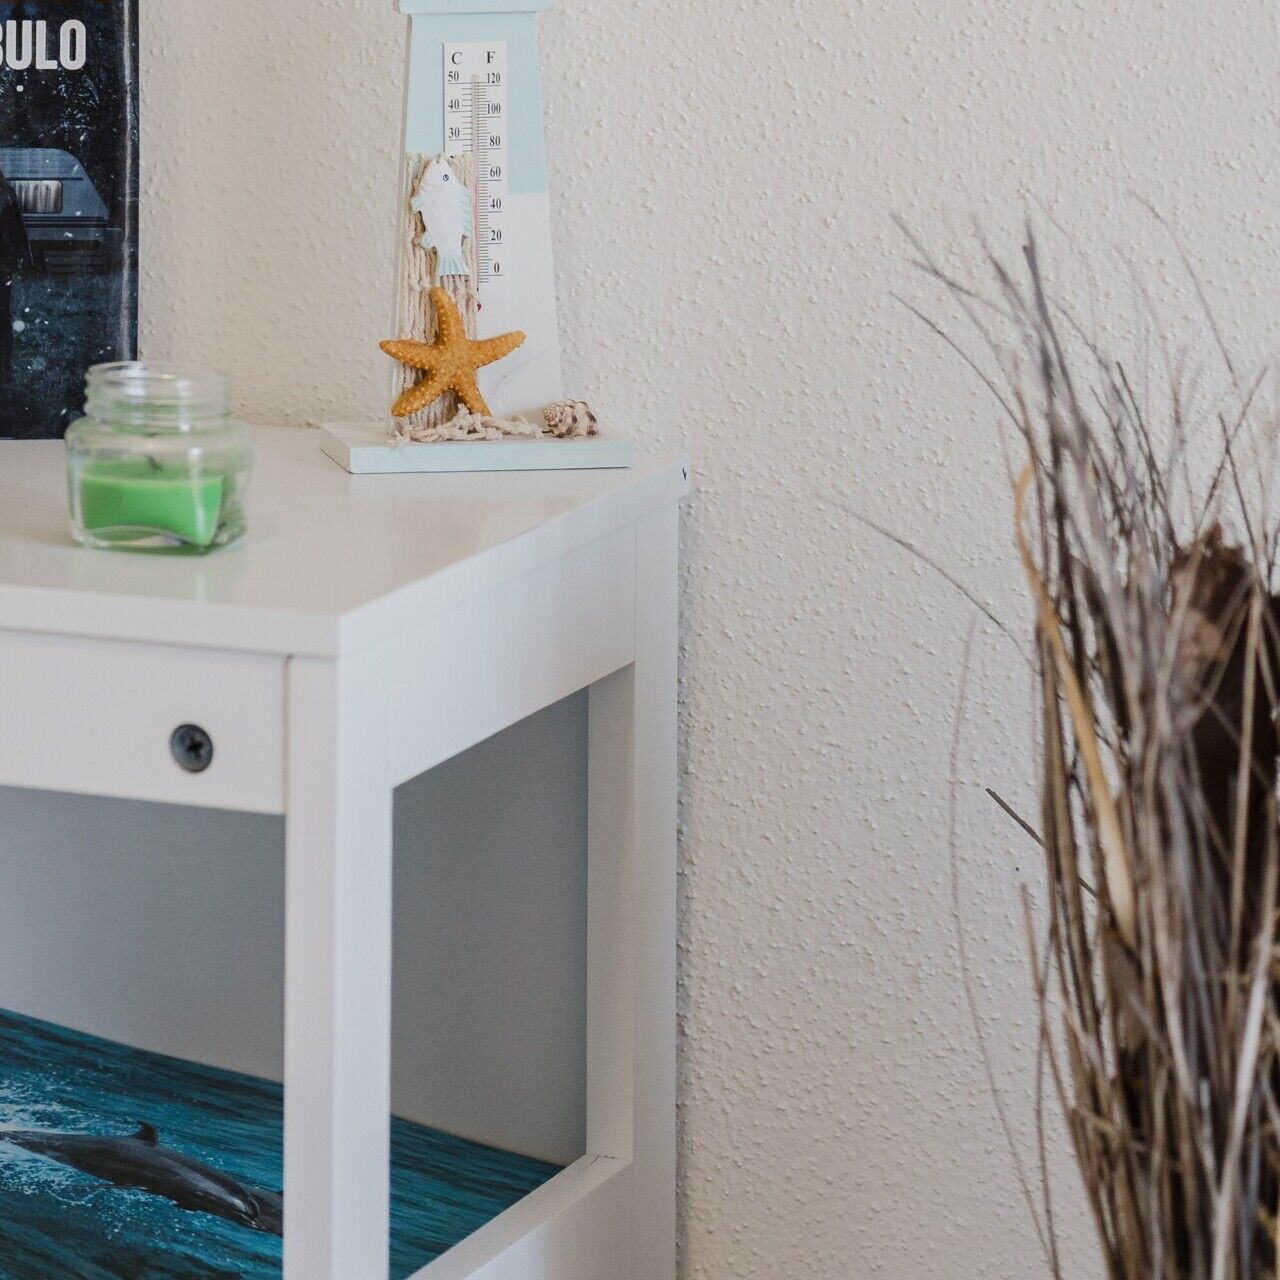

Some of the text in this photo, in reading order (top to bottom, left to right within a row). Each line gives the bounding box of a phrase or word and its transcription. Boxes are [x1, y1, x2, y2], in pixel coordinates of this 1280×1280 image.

[451, 51, 463, 65] C
[486, 51, 496, 64] F
[447, 70, 460, 82] 50
[486, 72, 501, 84] 120
[447, 98, 460, 111] 40
[486, 103, 501, 115] 100
[448, 126, 460, 139] 30
[489, 135, 501, 147] 80
[489, 166, 501, 178] 60
[490, 198, 502, 210] 40
[490, 229, 502, 241] 20
[493, 261, 500, 273] 0
